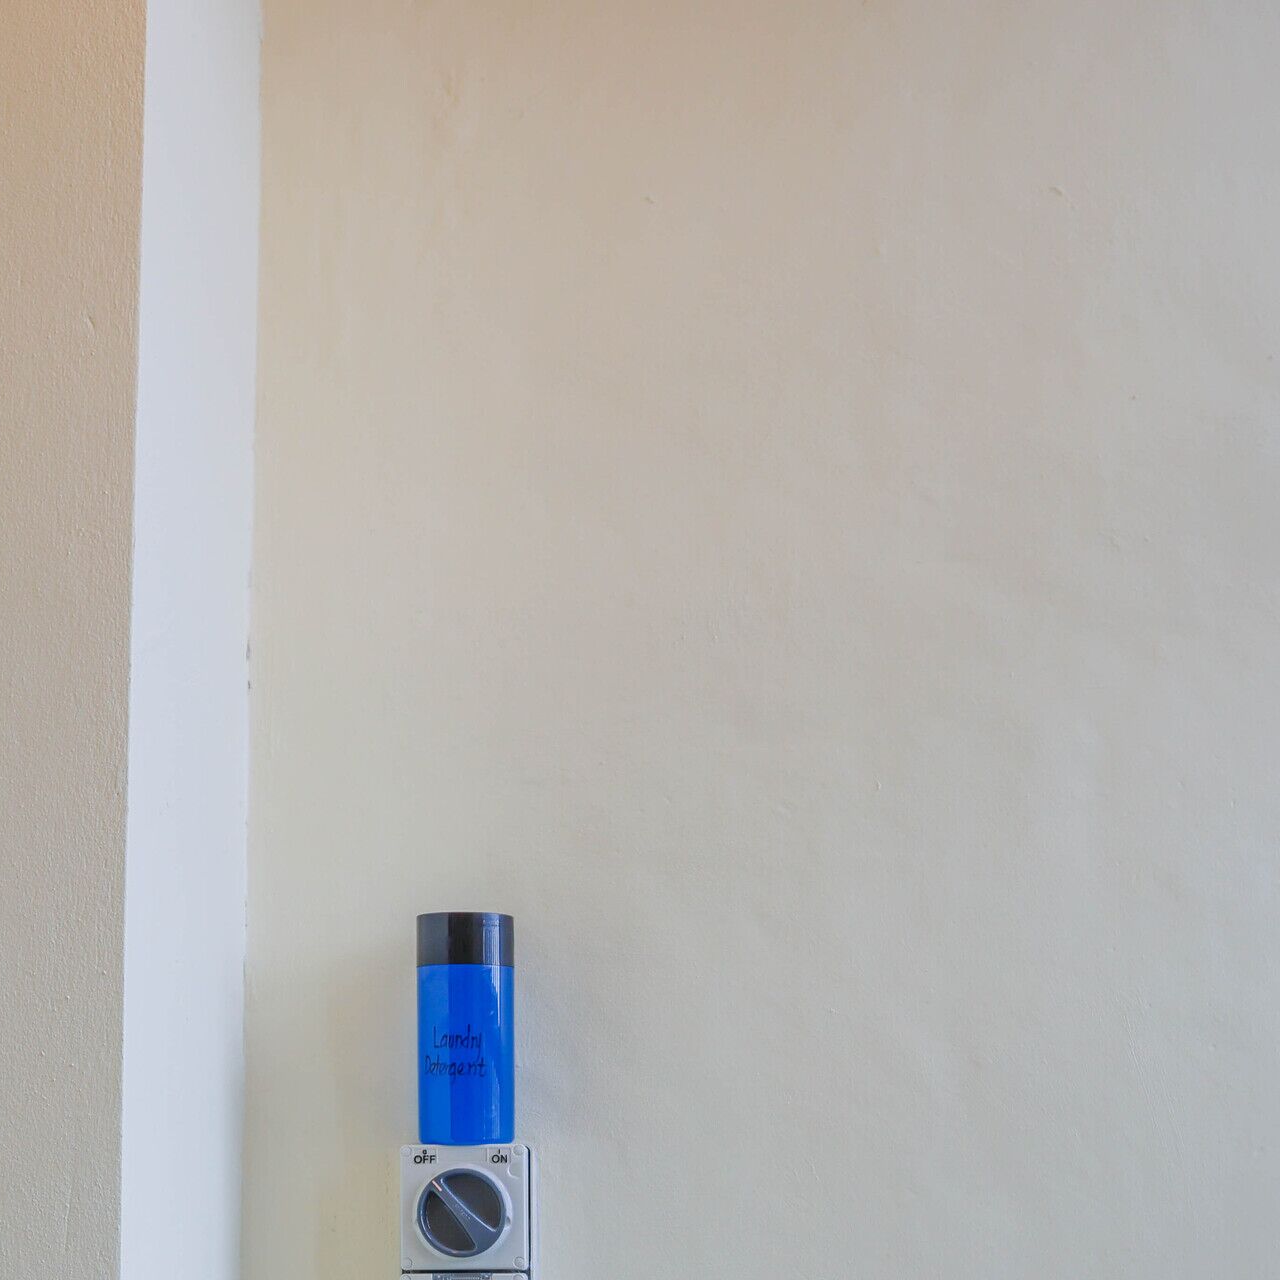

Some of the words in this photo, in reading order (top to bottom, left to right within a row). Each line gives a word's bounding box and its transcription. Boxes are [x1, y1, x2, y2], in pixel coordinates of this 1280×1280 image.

[433, 1024, 482, 1060] Laundry
[425, 1055, 486, 1081] Detergent
[414, 1155, 436, 1164] OFF
[491, 1154, 508, 1163] ON
